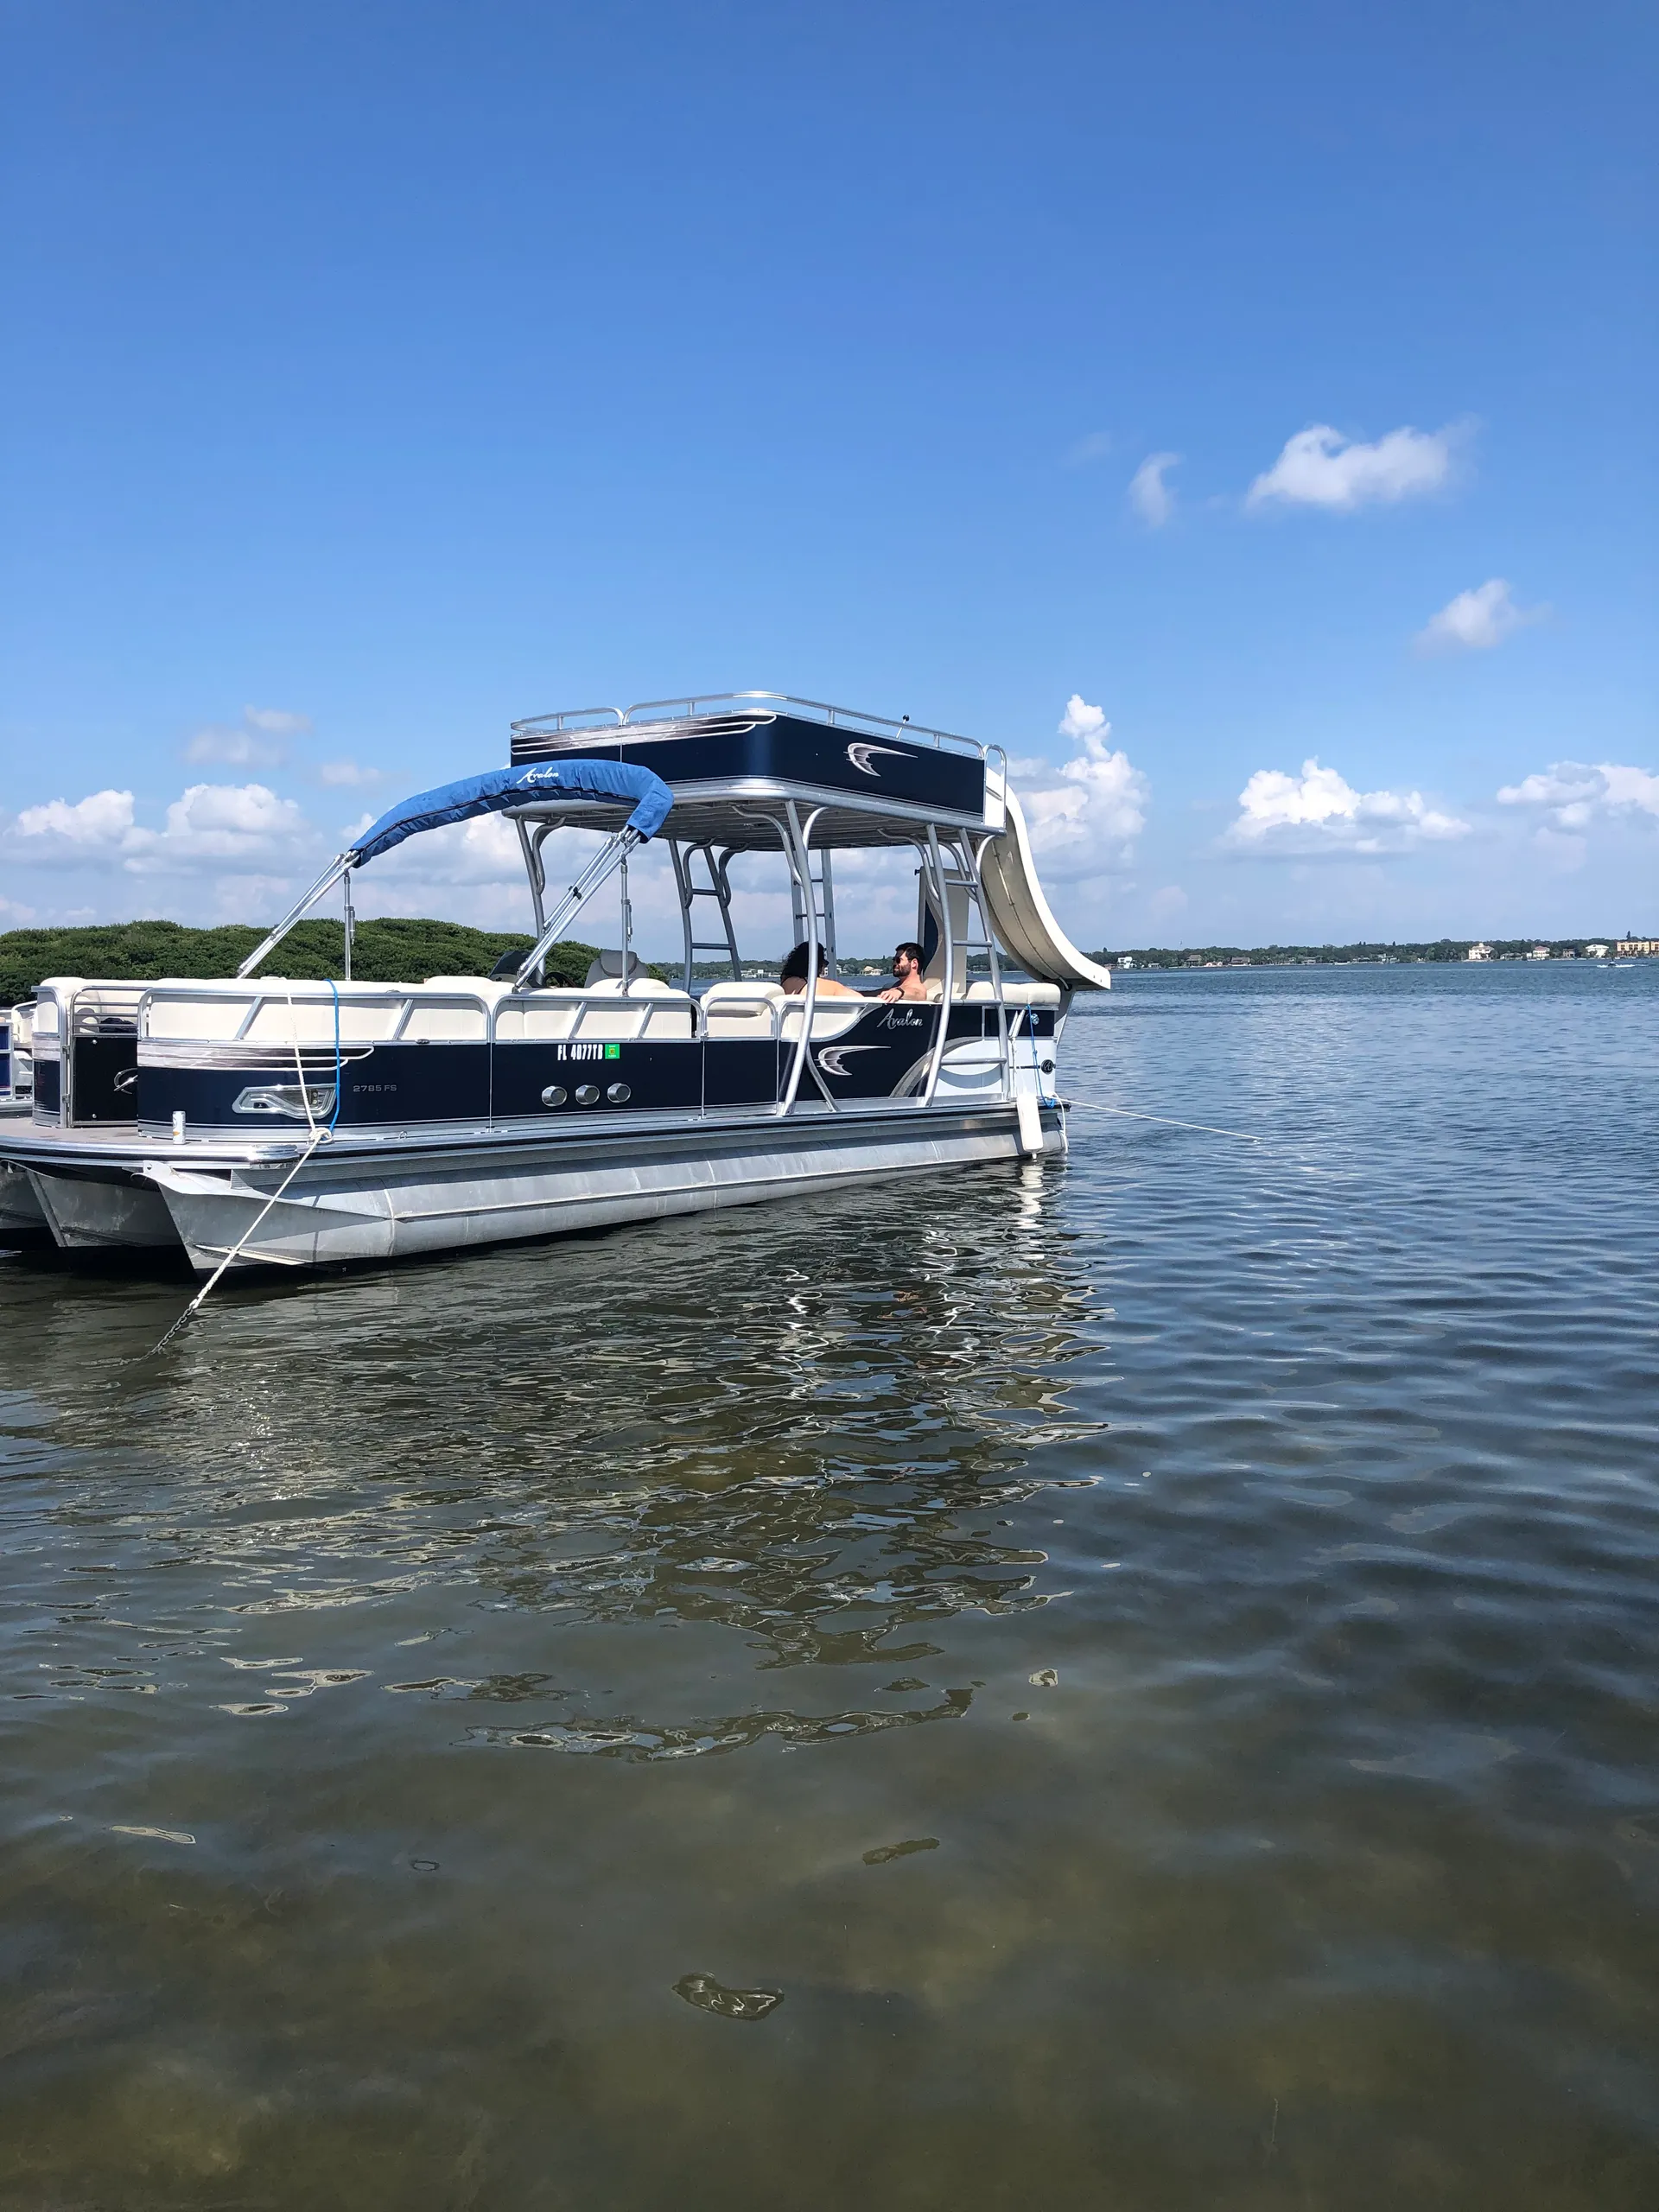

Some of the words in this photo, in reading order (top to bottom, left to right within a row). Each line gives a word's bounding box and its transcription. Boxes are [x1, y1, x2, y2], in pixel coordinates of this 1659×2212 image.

[516, 766, 559, 784] Avalon
[876, 1007, 924, 1030] Avalon
[557, 1044, 568, 1061] FL
